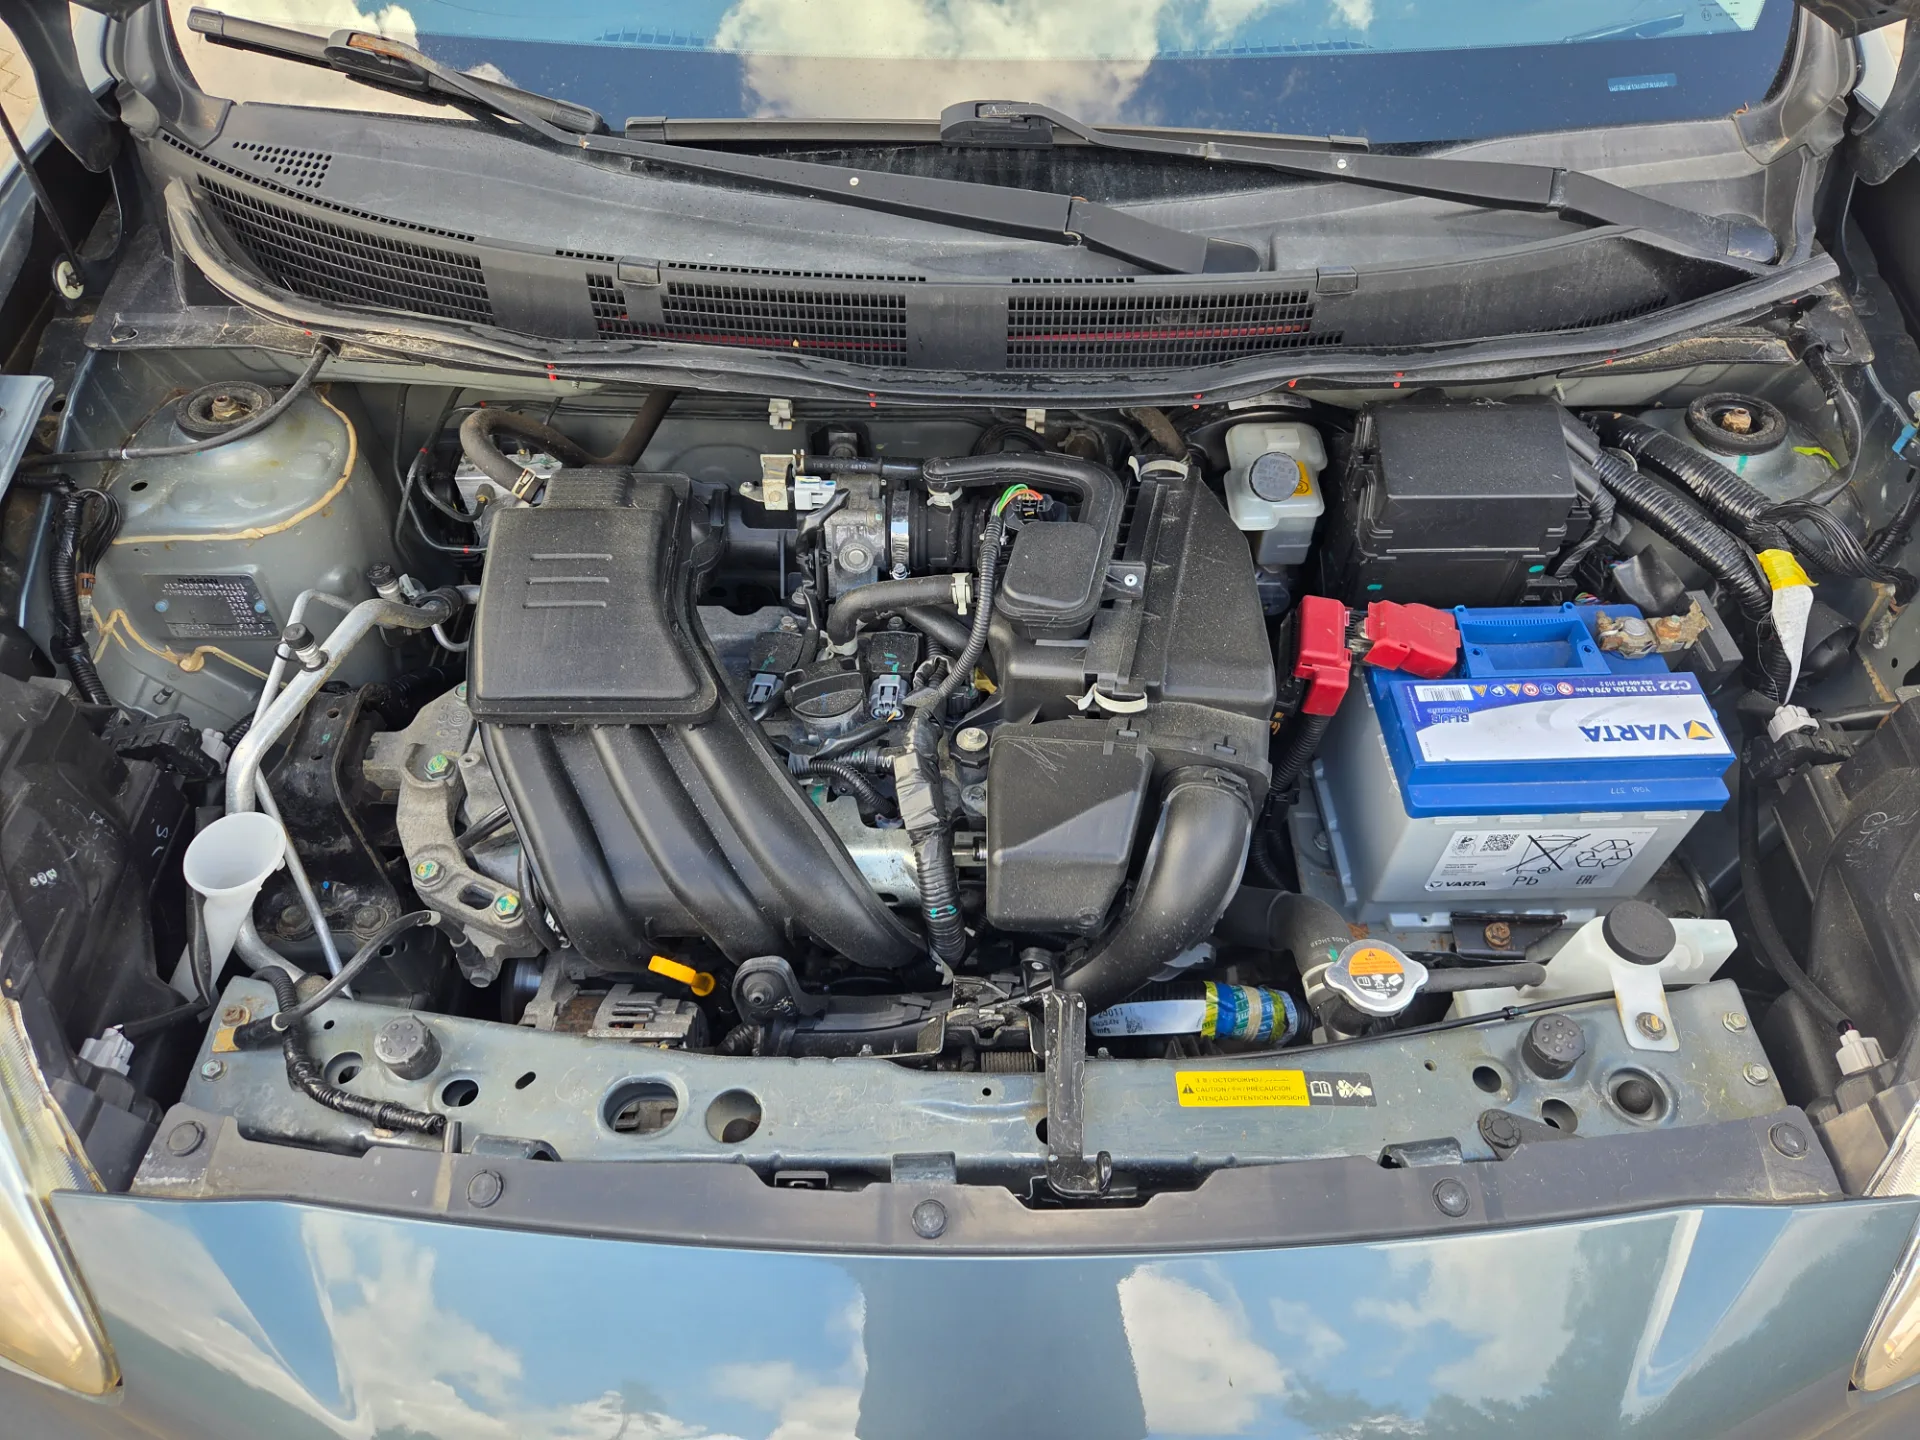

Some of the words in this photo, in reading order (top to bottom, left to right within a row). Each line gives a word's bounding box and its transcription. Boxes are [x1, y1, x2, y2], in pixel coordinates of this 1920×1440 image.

[1640, 685, 1657, 693] 12V
[1658, 680, 1692, 691] C22
[1427, 706, 1470, 715] Dynamic
[1431, 713, 1471, 725] BLUE
[1578, 724, 1682, 742] VARTA
[1446, 880, 1487, 889] VARTA
[1513, 875, 1539, 886] Pb
[1092, 1018, 1119, 1027] NISSAN
